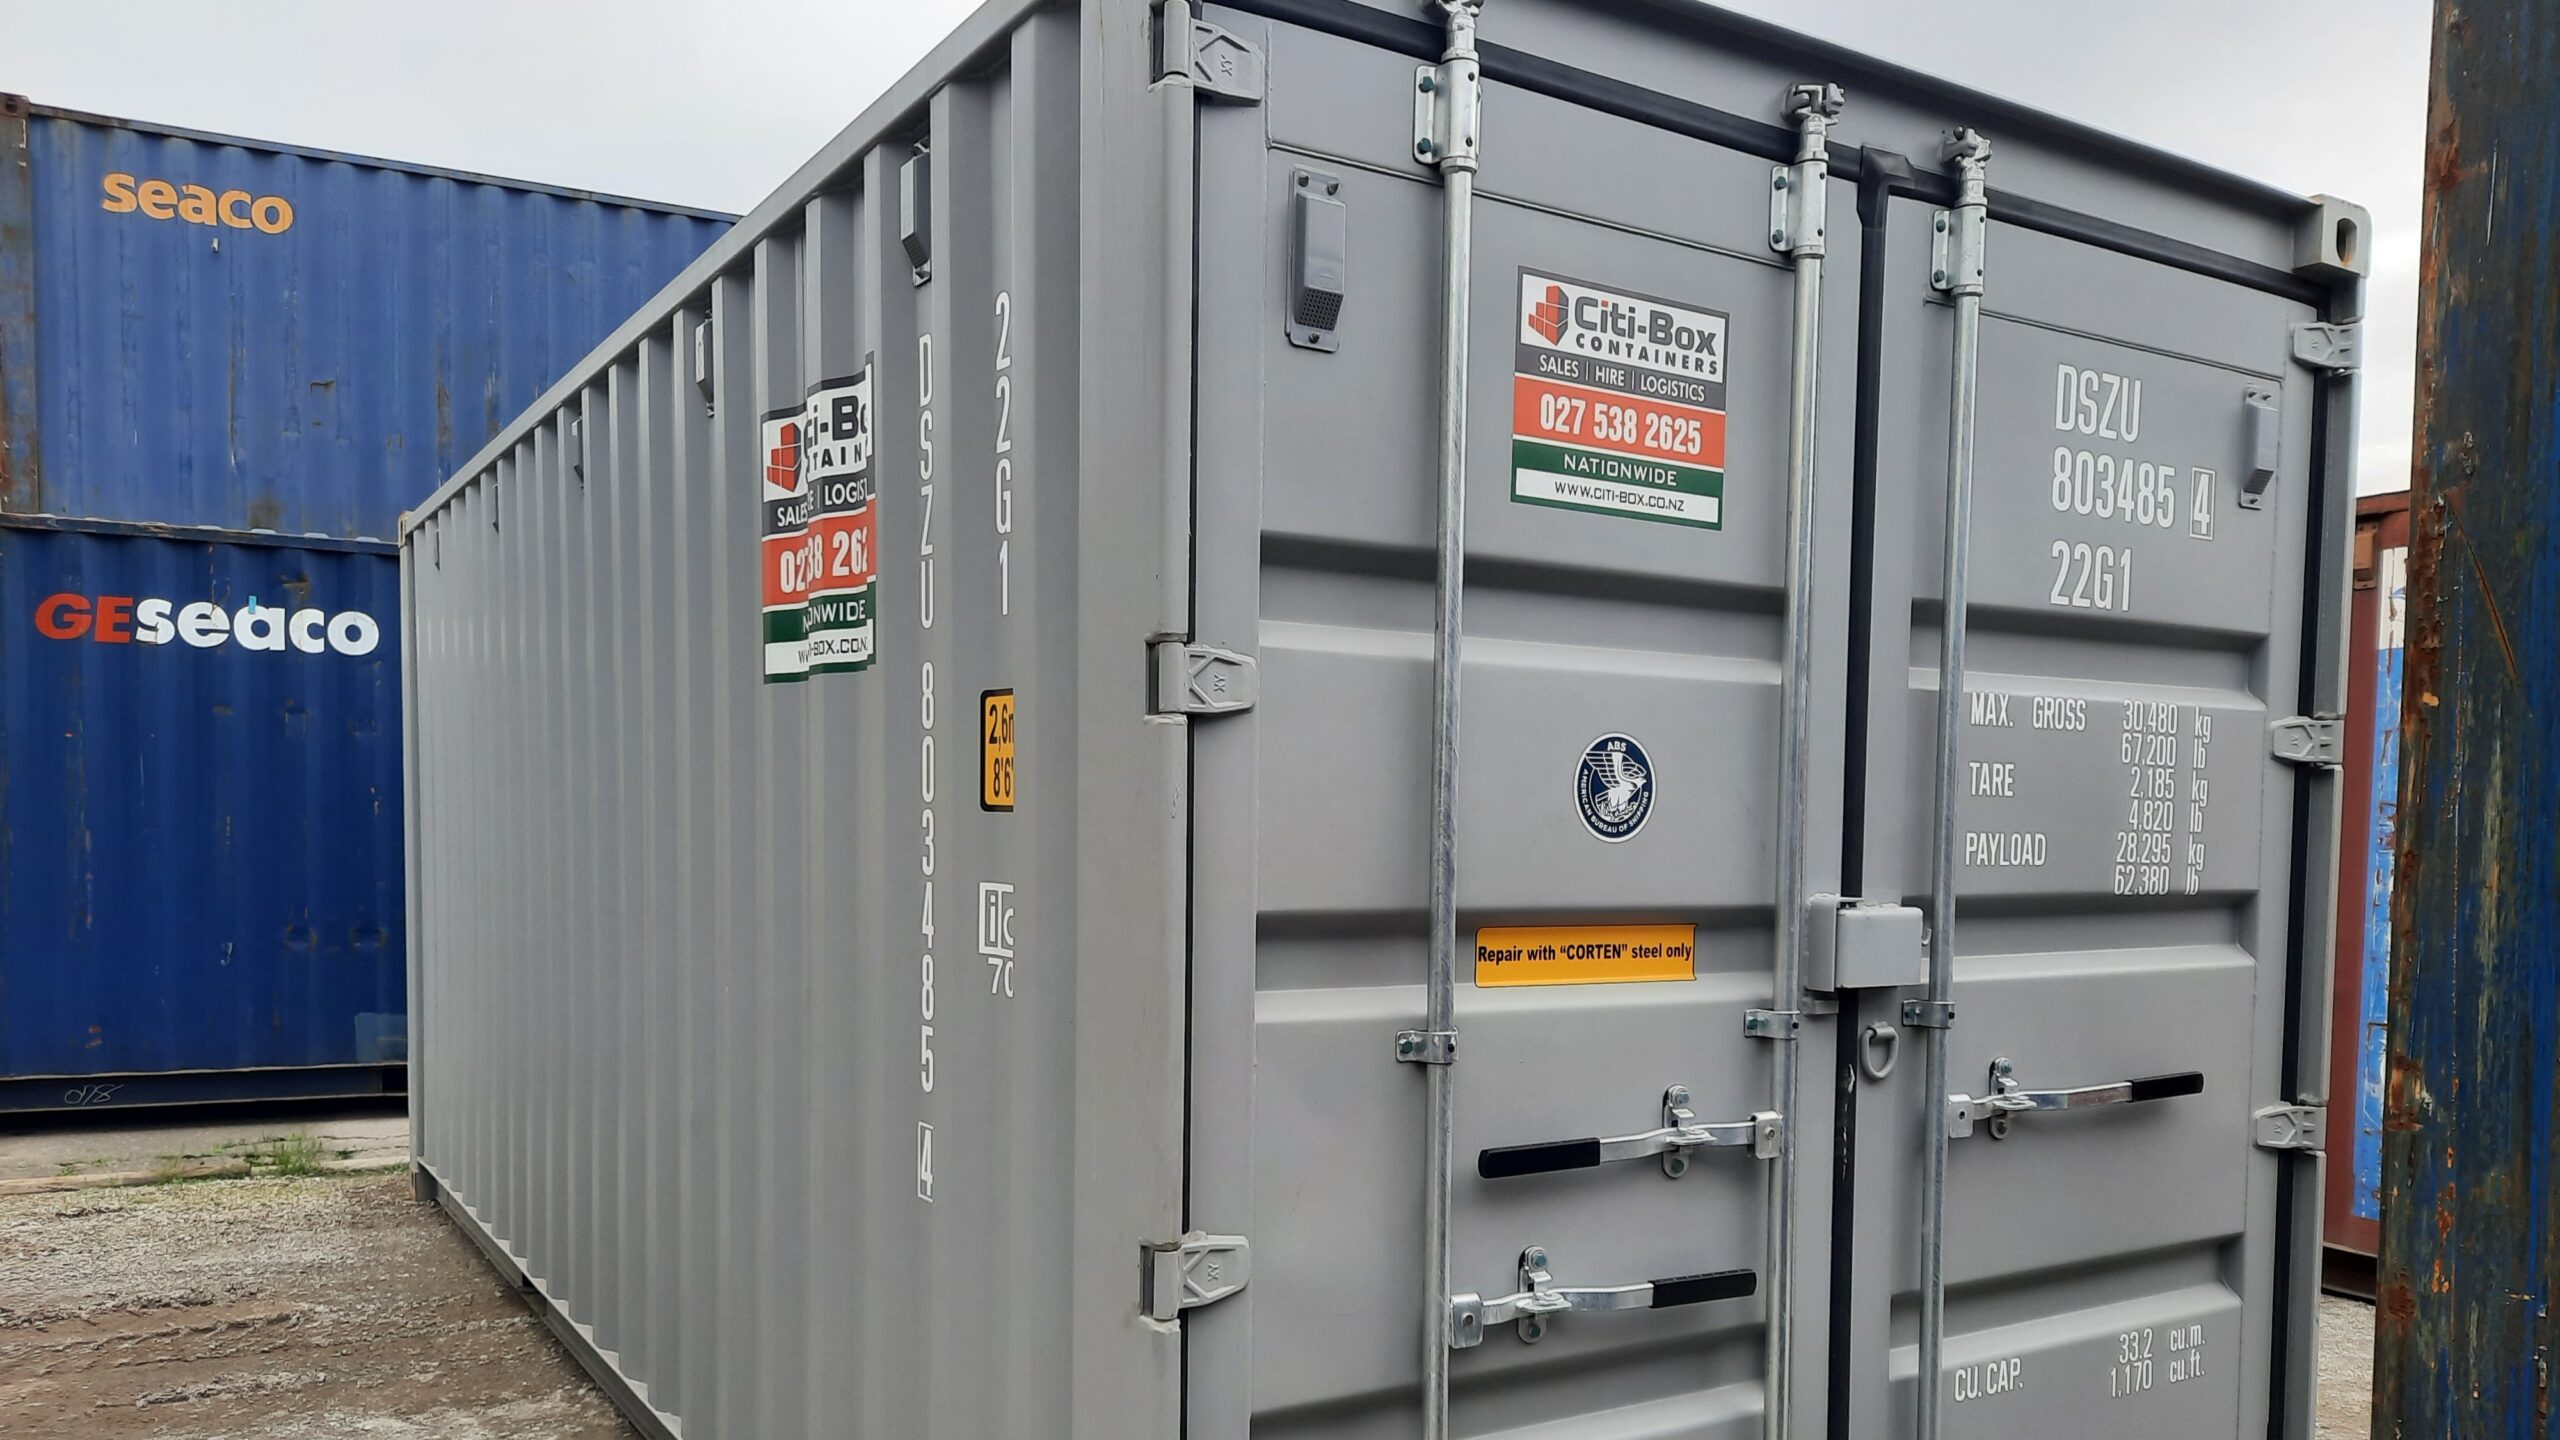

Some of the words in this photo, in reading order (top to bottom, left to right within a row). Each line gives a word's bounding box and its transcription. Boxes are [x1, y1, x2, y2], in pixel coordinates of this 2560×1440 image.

[102, 172, 294, 235] seaco
[1574, 296, 1717, 356] Citi-Box
[1576, 333, 1718, 376] CONTAINERS
[1539, 355, 1579, 377] SALES
[1595, 366, 1625, 387] HIRE
[1640, 375, 1705, 402] LOGISTICS
[1540, 393, 1587, 435] 027
[1594, 403, 1637, 444] 538
[1645, 413, 1702, 455] 2625
[2056, 363, 2142, 443] DSZU
[1564, 454, 1677, 486] NATIONWIDE
[2051, 446, 2177, 528] 803485
[2192, 470, 2213, 538] 4
[1555, 481, 1684, 512] WWW.CITI-BOX.CO.NZ
[2050, 540, 2132, 612] 22G1
[1970, 691, 2014, 728] MAX.
[2032, 696, 2086, 731] GROSS
[2122, 700, 2177, 734] 30,480
[2194, 706, 2212, 743] kg
[1607, 741, 1627, 752] ABS
[2193, 738, 2206, 769] lb
[1581, 768, 1594, 817] AMERICAN
[1590, 816, 1617, 833] BUREAU
[1629, 791, 1649, 827] SHIPPING
[1969, 761, 2014, 797] TARE
[2191, 770, 2208, 807] kg
[2190, 802, 2202, 832] lb
[1965, 832, 2046, 866] PAYLOAD
[2188, 834, 2204, 871] kg
[2114, 864, 2169, 895] 62,380
[2184, 866, 2199, 895] lb
[1478, 945, 1523, 965] Repair
[1527, 945, 1556, 960] with
[1560, 943, 1628, 960] “CORTEN”
[1631, 943, 1662, 958] steel
[1666, 943, 1692, 962] only
[2118, 1327, 2153, 1364] 33.2
[2169, 1324, 2206, 1352] cu.m.
[2110, 1359, 2153, 1398] 1,170
[2168, 1348, 2206, 1383] cu.ft.
